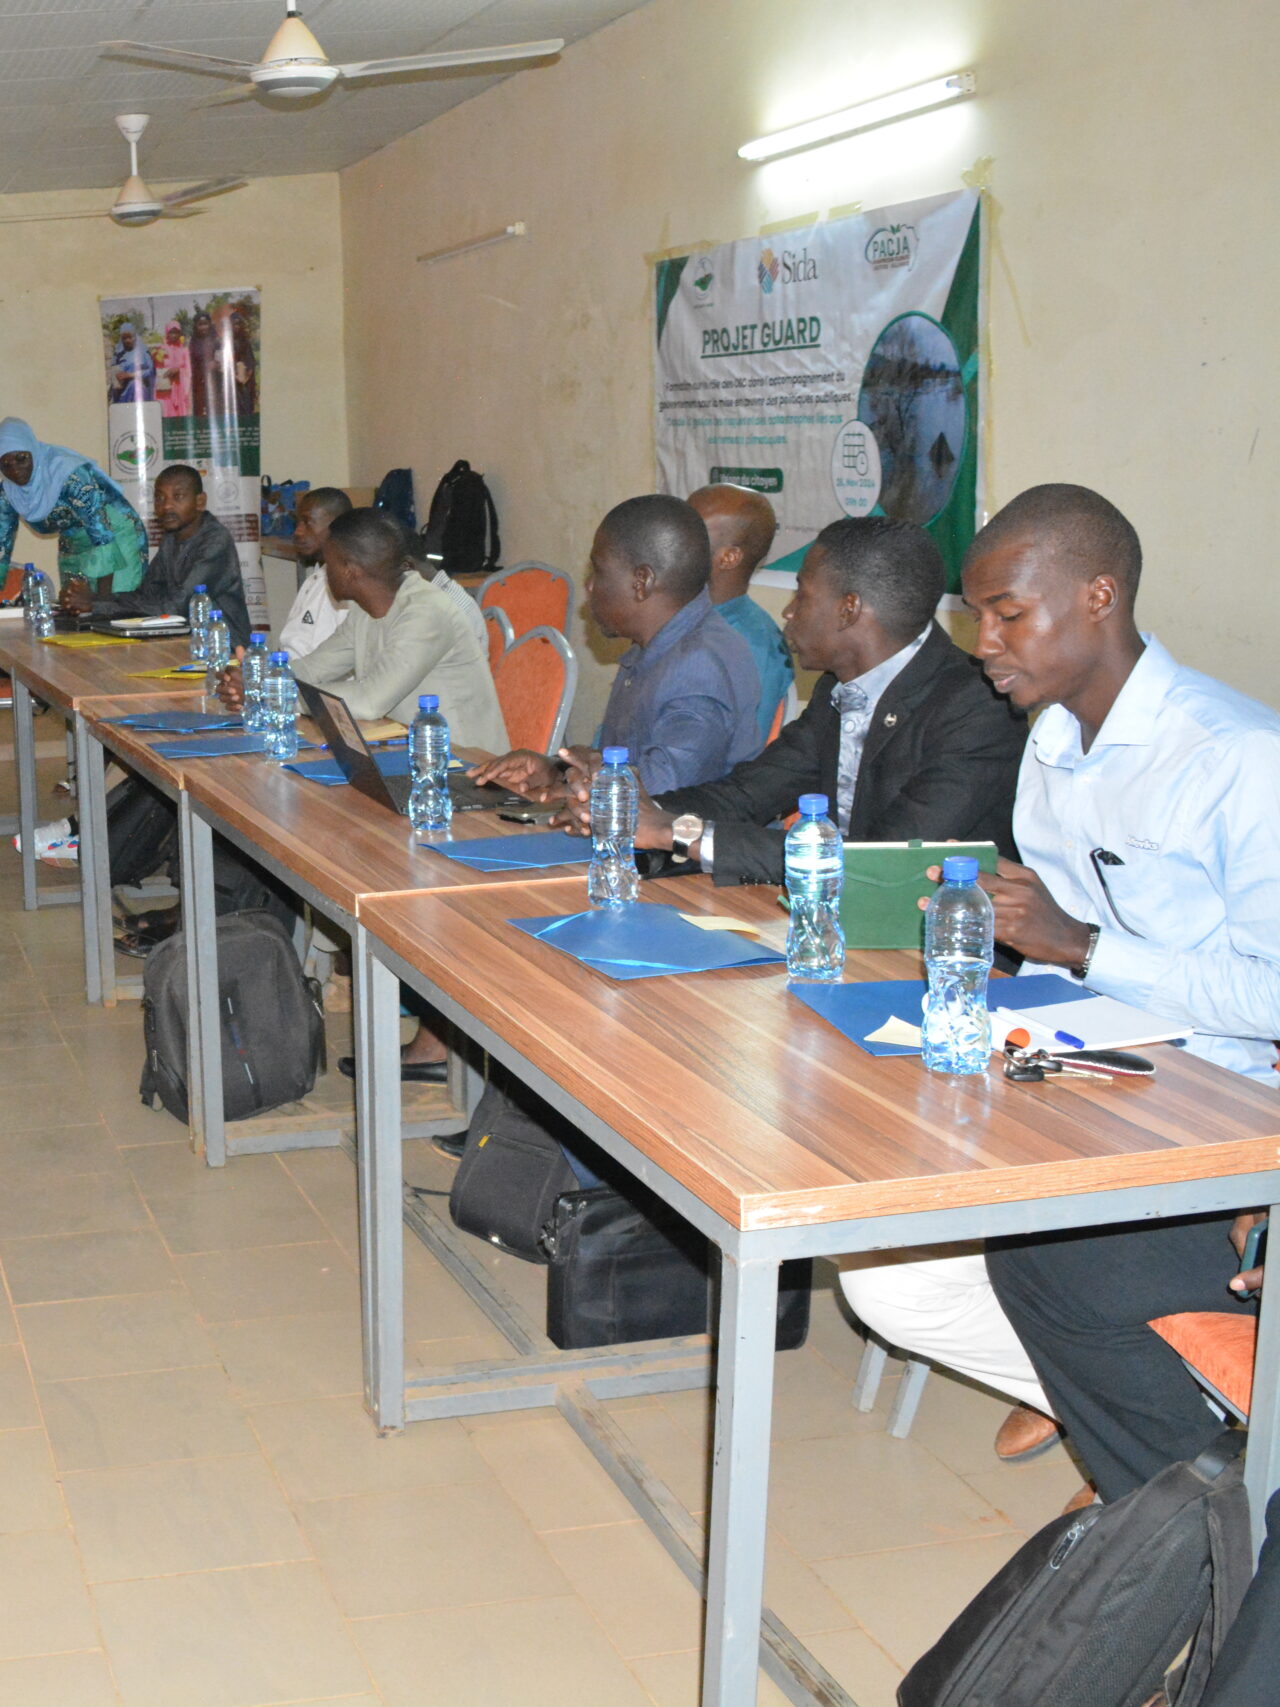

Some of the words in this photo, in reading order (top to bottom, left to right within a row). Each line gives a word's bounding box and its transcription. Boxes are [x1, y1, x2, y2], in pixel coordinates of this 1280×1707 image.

[872, 236, 910, 258] PACJA
[782, 248, 819, 285] Sida
[702, 323, 759, 354] PROJET
[760, 316, 821, 347] GUARD
